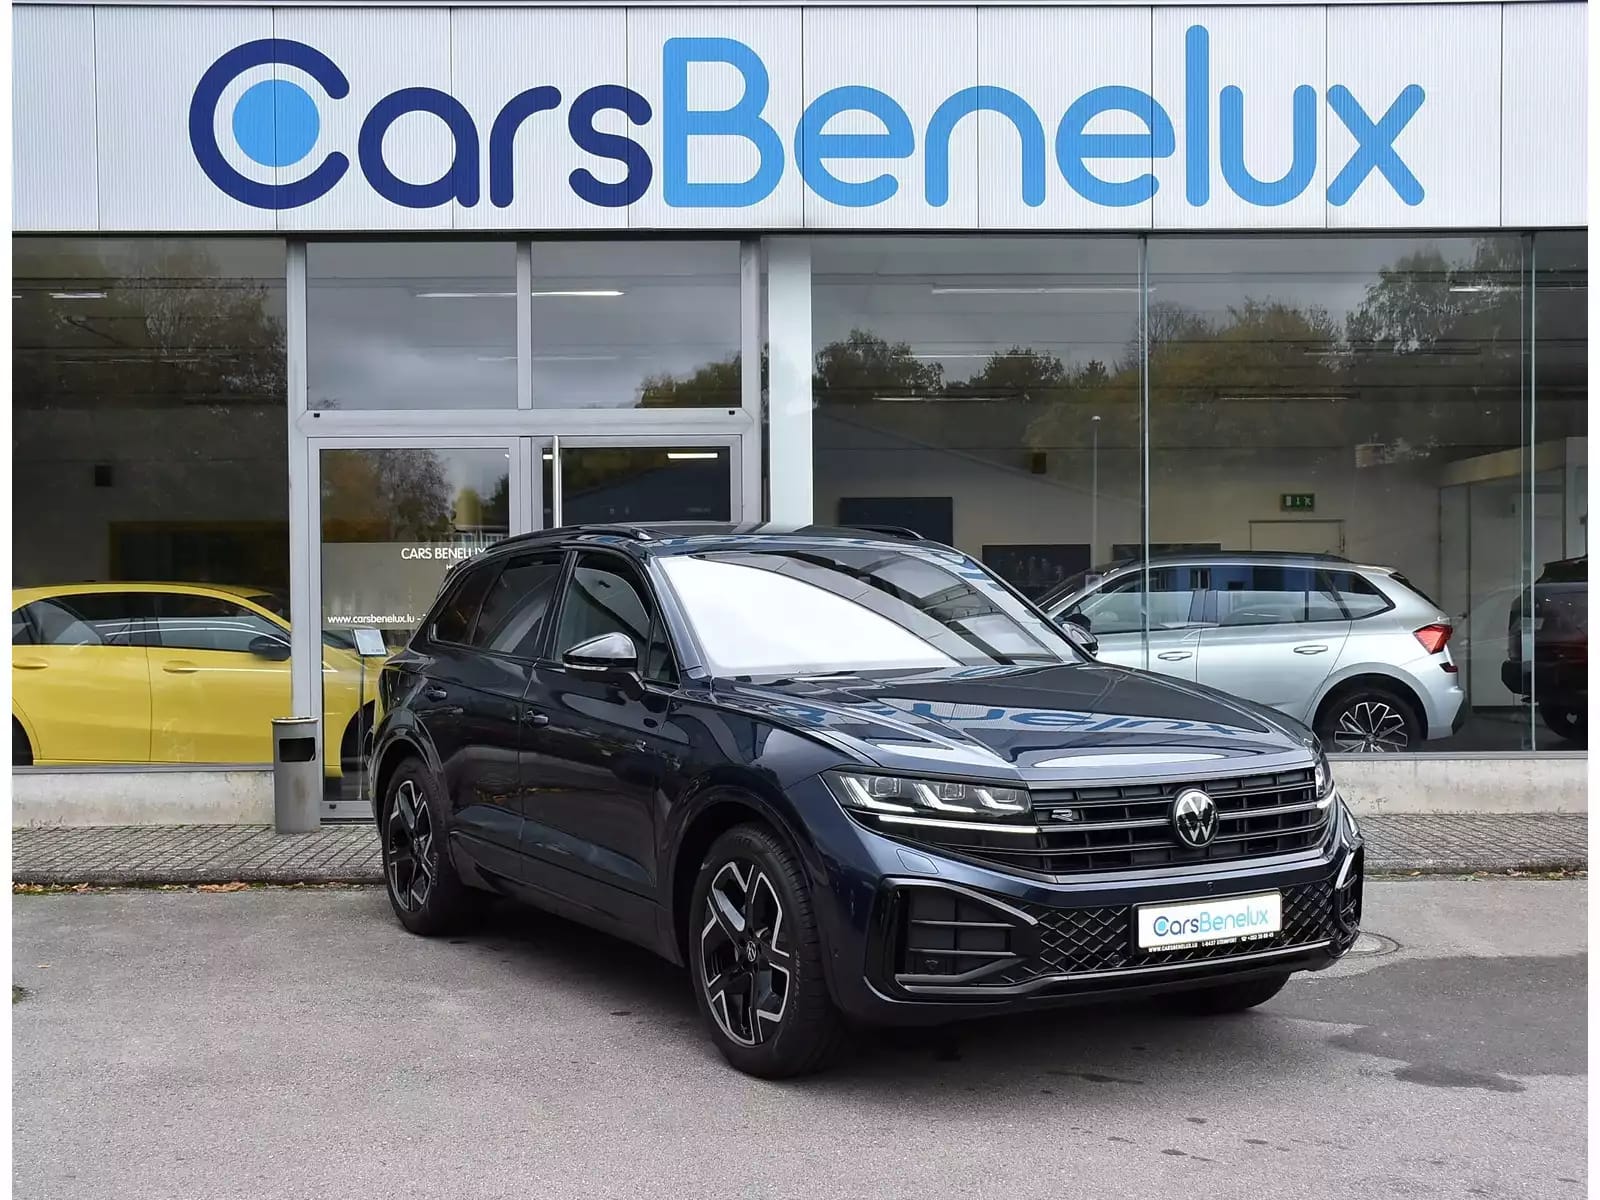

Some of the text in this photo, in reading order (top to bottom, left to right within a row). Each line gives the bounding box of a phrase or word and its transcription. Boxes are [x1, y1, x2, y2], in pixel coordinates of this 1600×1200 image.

[189, 25, 1425, 208] CarsBenelux
[401, 547, 433, 560] CARS
[327, 613, 415, 624] www.carsbenelux.lu
[1153, 905, 1269, 937] CarsBenelux
